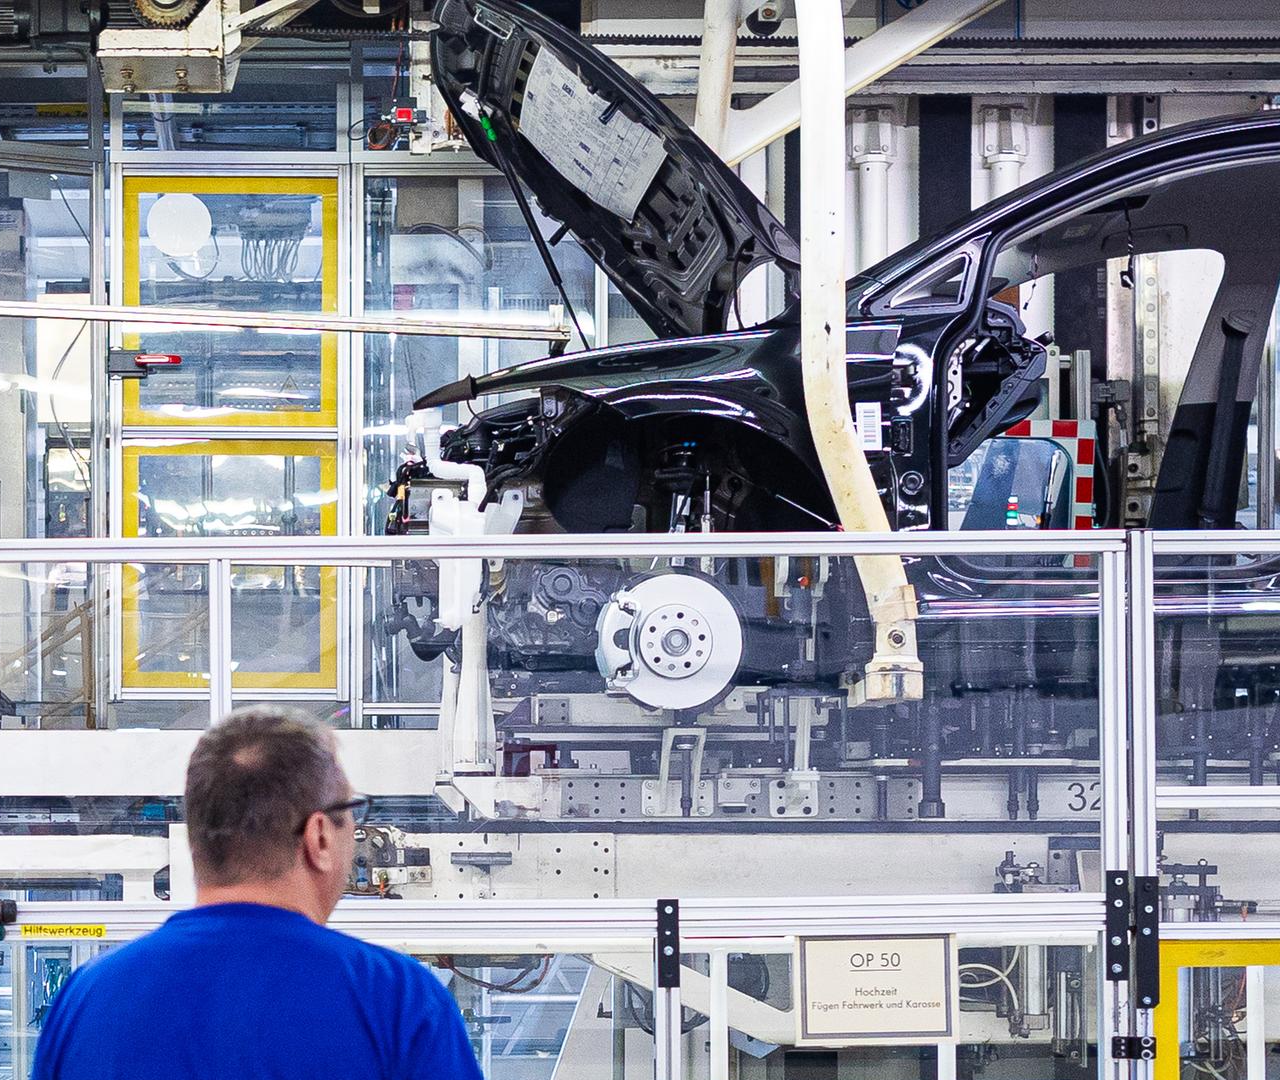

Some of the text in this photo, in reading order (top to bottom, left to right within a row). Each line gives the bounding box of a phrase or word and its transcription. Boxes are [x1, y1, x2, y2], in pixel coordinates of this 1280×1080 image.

[23, 925, 103, 937] Hilfswerkzeug
[850, 952, 901, 968] OP 50
[855, 987, 897, 997] Hochzeit
[812, 1000, 941, 1012] Fügen Fahrwerk und Karosse
